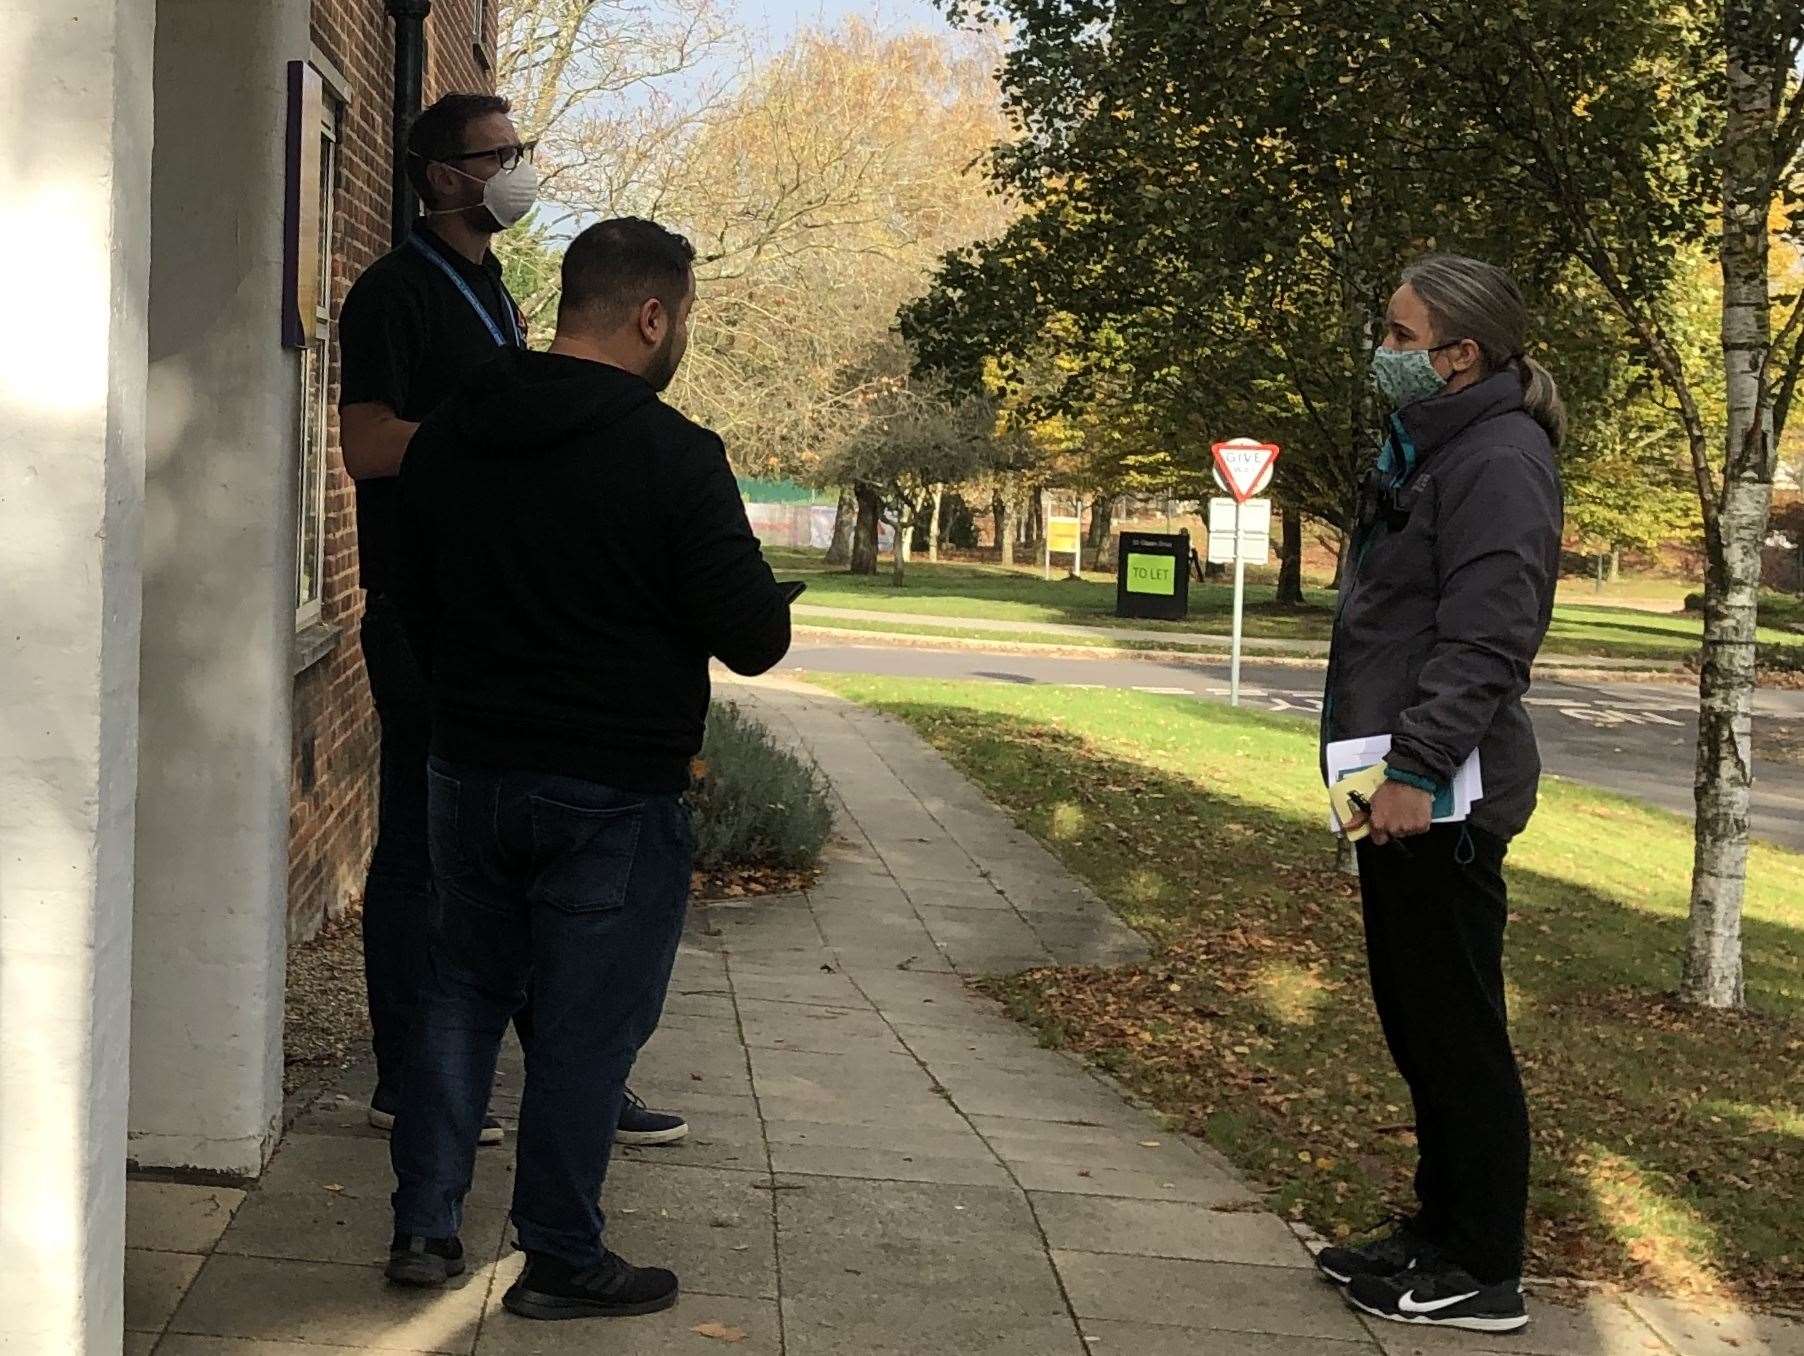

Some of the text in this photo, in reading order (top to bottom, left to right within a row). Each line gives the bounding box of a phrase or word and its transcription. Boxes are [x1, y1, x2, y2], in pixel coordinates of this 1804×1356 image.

[1225, 452, 1261, 463] GIVE
[1133, 567, 1169, 580] TO LET
